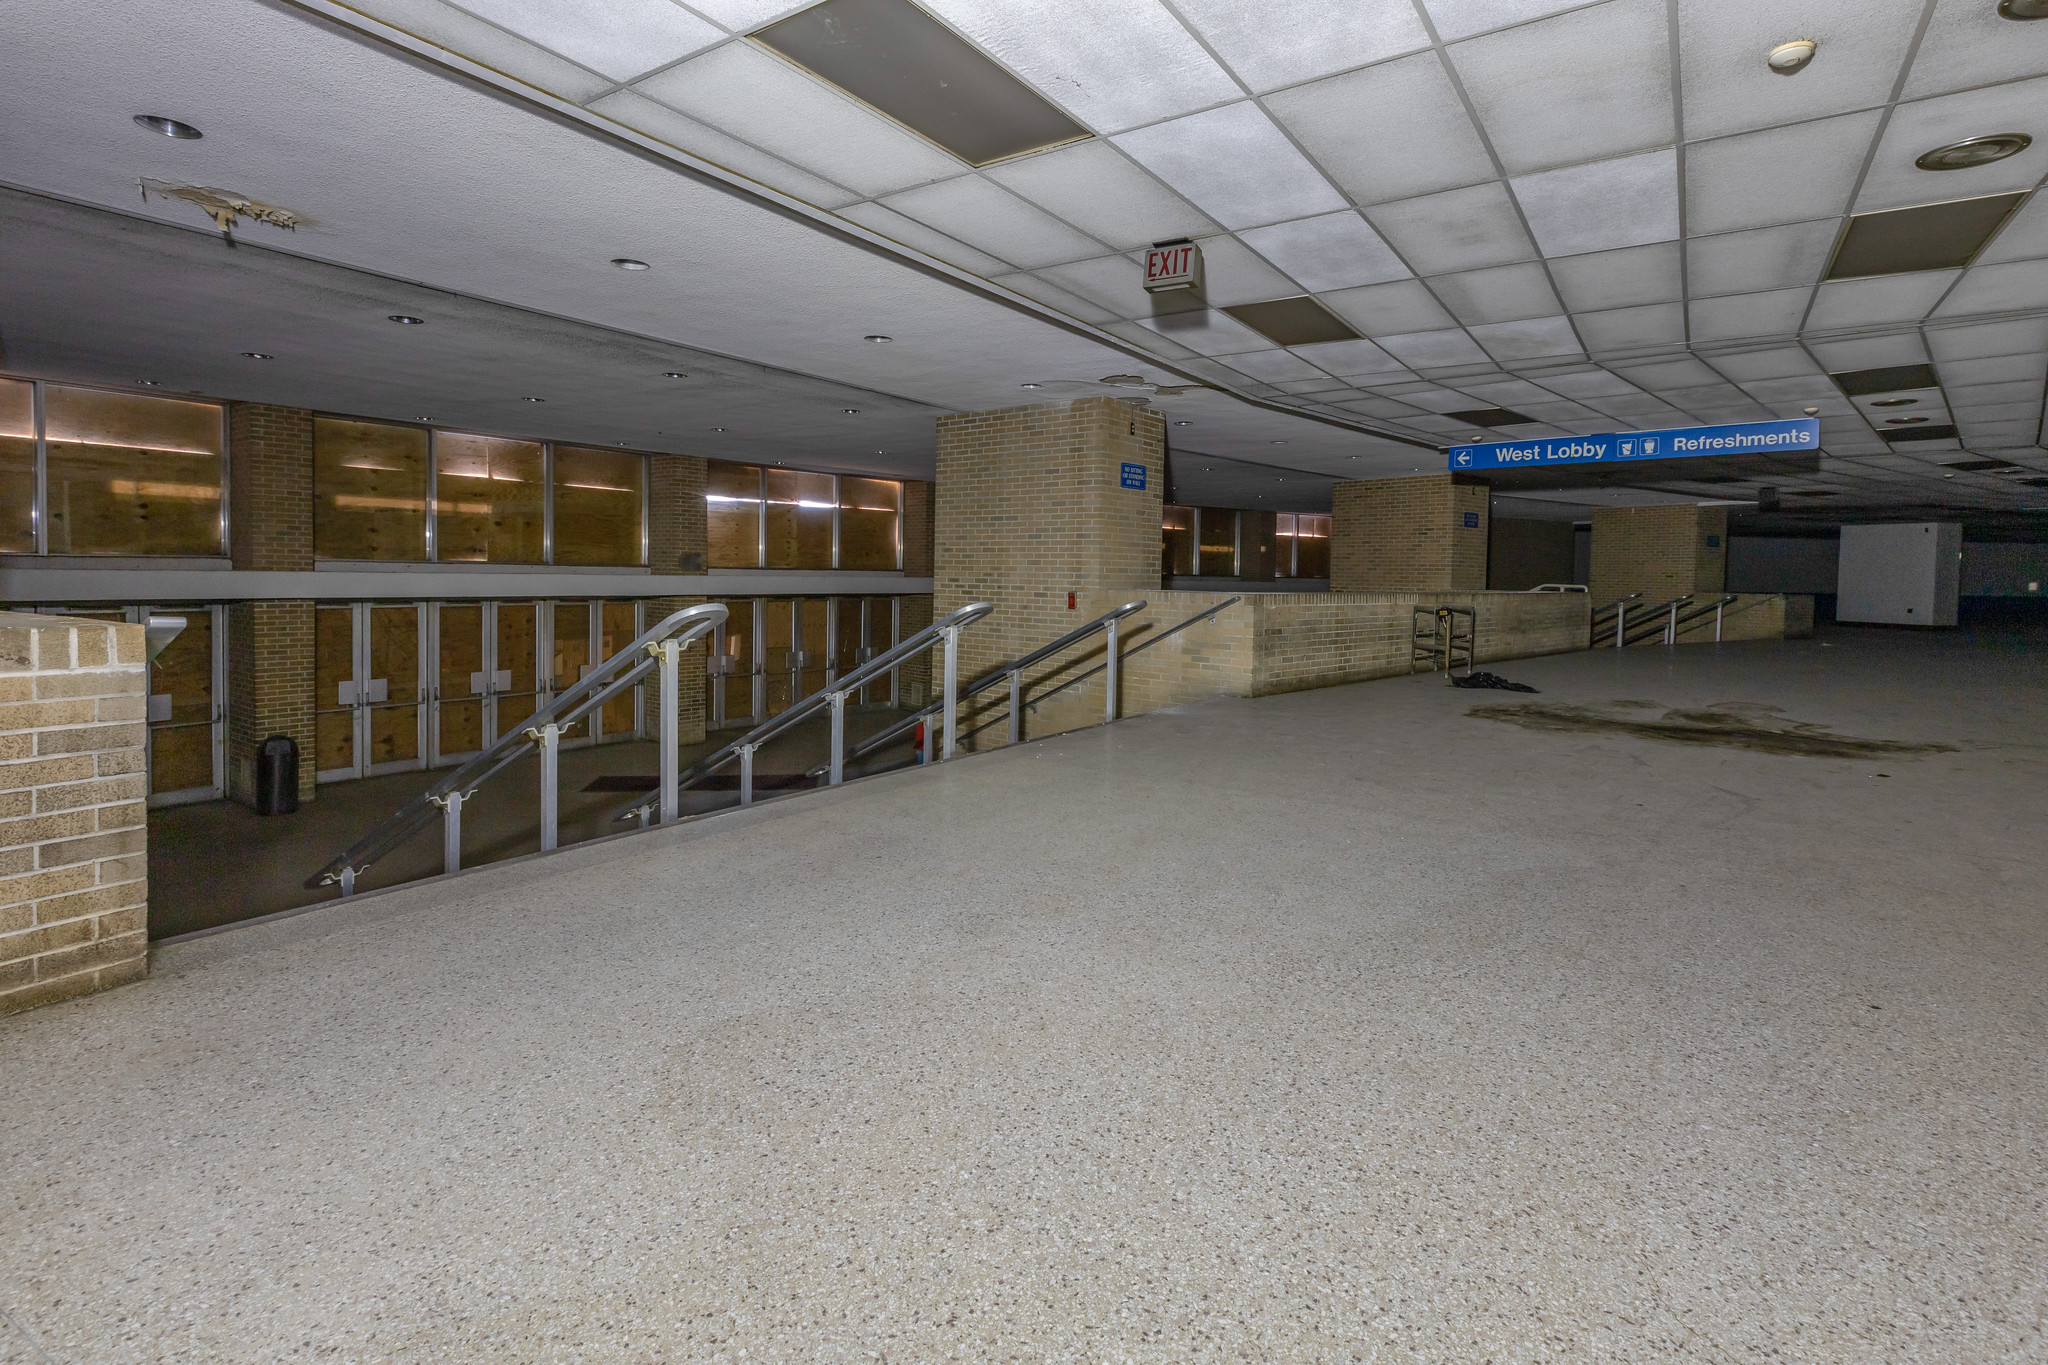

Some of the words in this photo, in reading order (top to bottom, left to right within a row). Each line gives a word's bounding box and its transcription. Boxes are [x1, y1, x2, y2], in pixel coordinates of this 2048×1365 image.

[1148, 247, 1192, 277] EXIT
[1673, 429, 1811, 451] Refreshments
[1496, 446, 1540, 462] West
[1547, 442, 1606, 459] Lobby
